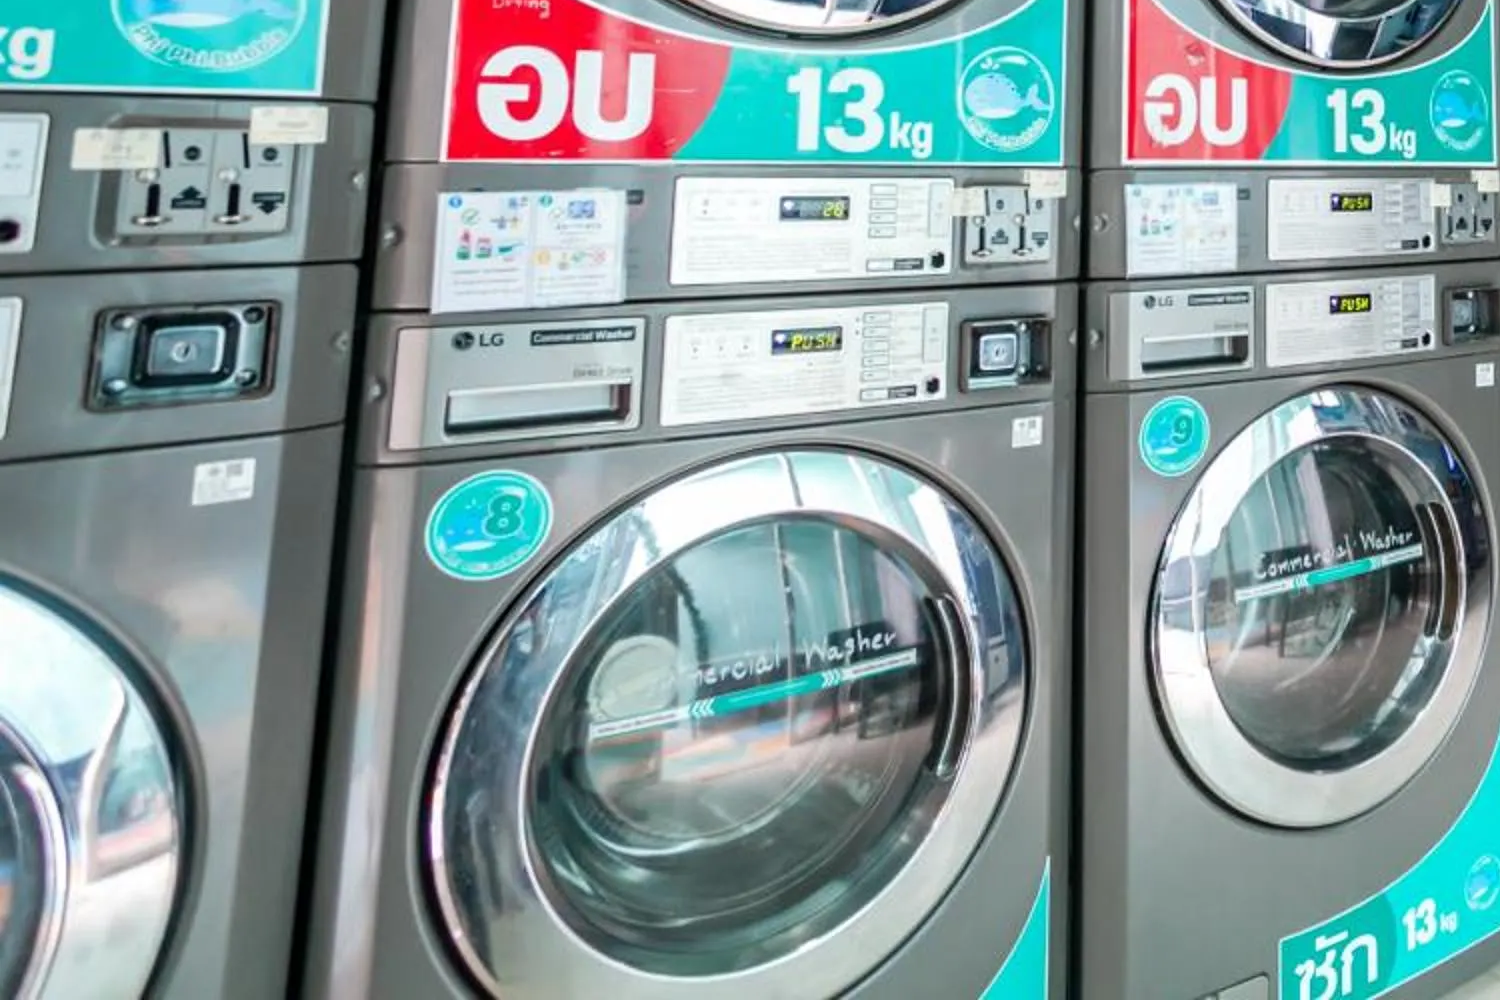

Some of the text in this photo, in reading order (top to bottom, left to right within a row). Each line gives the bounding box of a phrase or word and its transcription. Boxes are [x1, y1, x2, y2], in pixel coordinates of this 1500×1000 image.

[477, 45, 657, 144] อบ
[786, 66, 885, 153] 13
[889, 111, 933, 159] kg
[1142, 72, 1248, 149] อบ
[1326, 88, 1417, 159] 13 kg
[1157, 295, 1173, 308] LG
[479, 332, 505, 348] LG
[1171, 410, 1194, 445] 9
[481, 490, 526, 540] 8
[1253, 525, 1414, 580] Commercial Washer
[801, 627, 898, 668] Washer
[1401, 898, 1437, 950] 13
